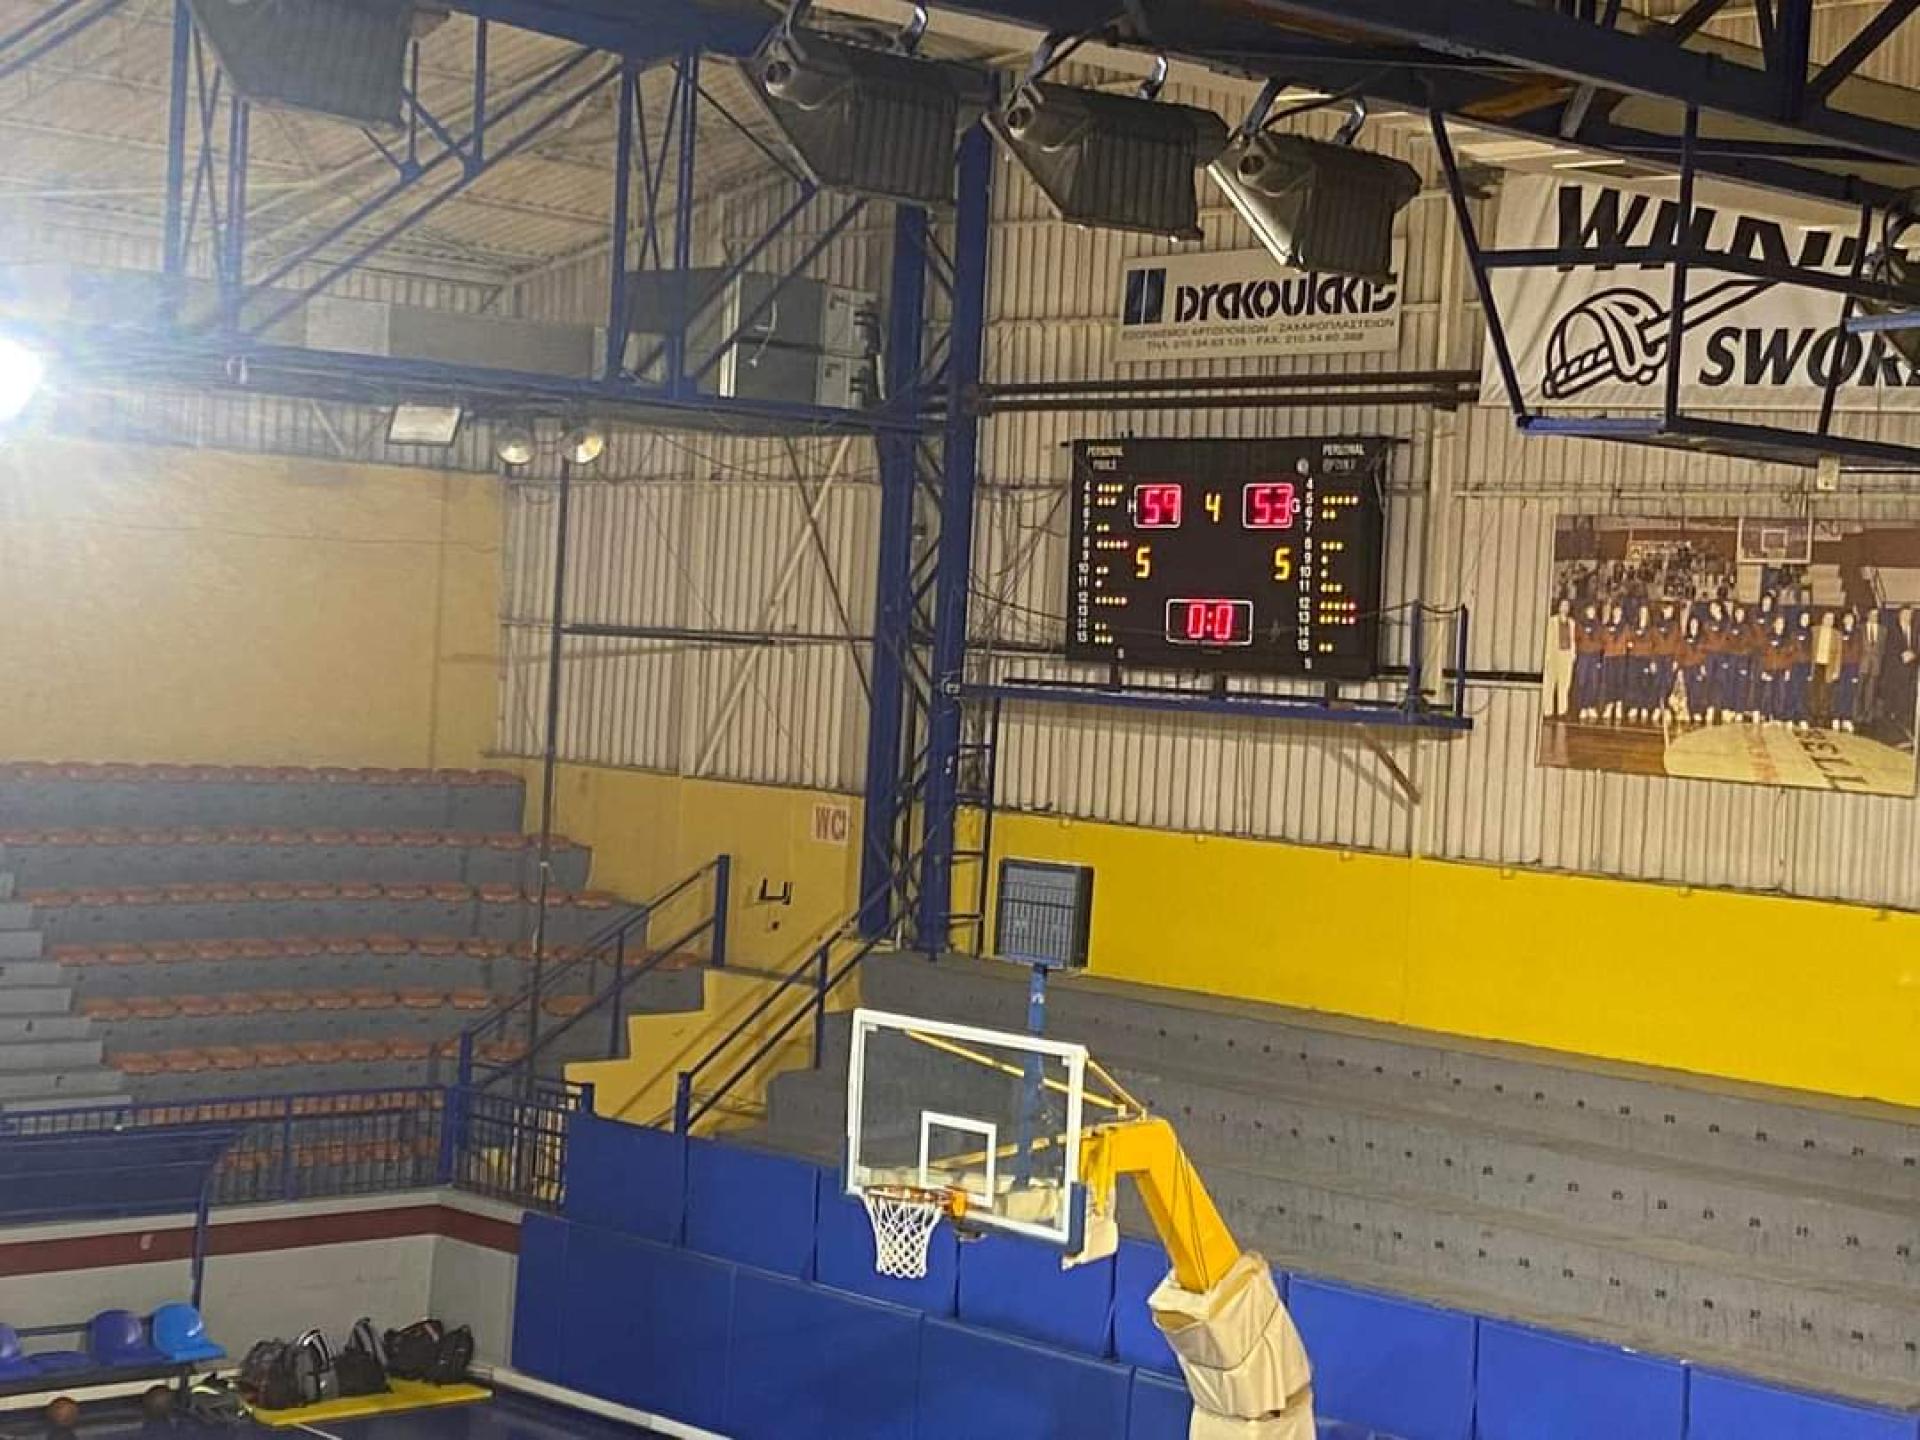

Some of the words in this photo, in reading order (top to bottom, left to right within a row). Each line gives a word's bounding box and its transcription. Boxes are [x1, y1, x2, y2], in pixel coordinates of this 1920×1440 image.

[1699, 326, 1920, 386] SWOR
[1144, 488, 1181, 524] 59
[1205, 493, 1221, 523] 4
[1253, 488, 1292, 524] 53
[1135, 546, 1151, 579] 5
[1273, 547, 1291, 581] 5
[1187, 603, 1234, 641] 0:0
